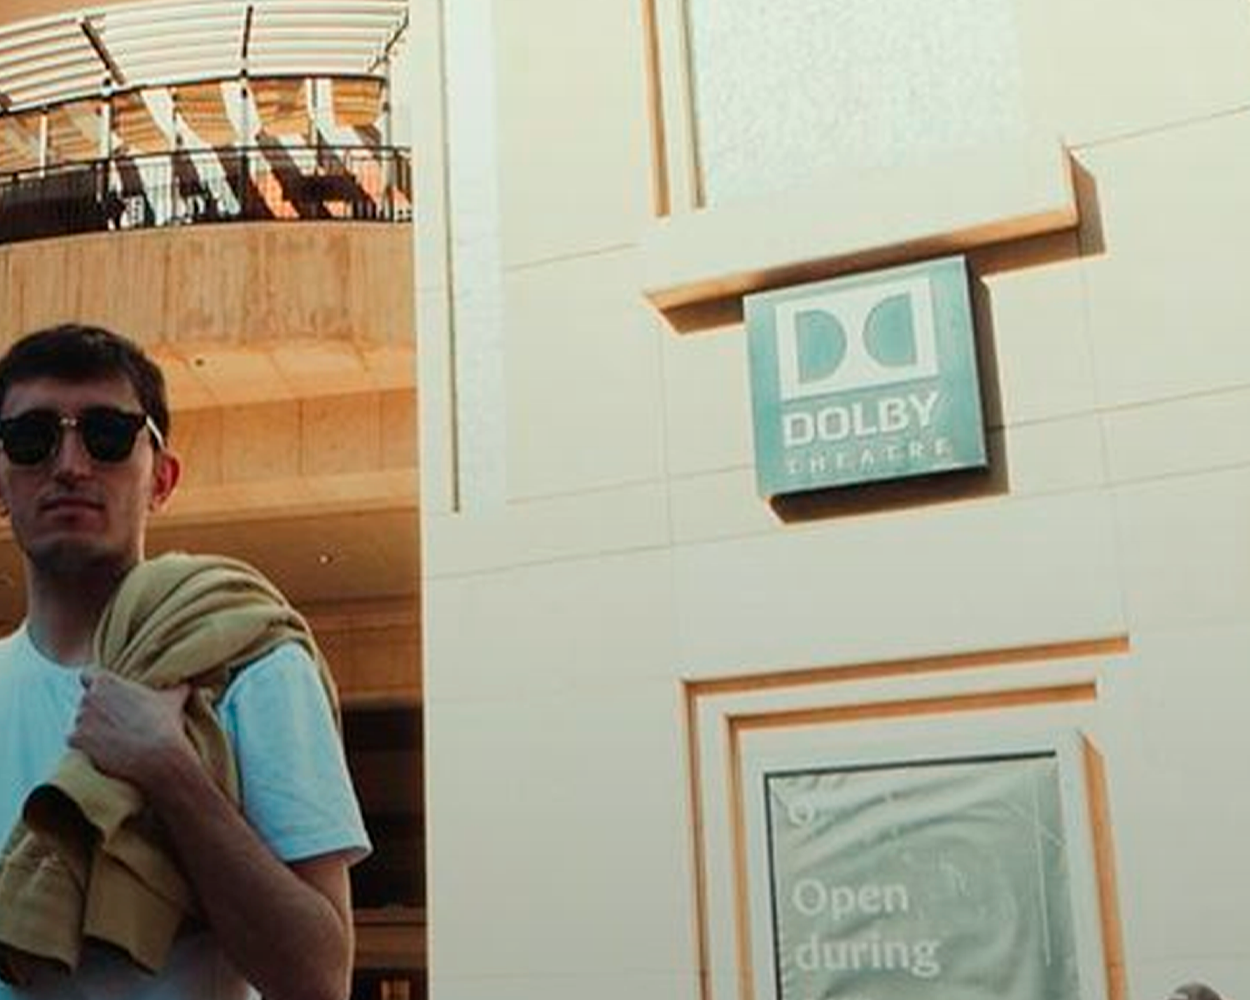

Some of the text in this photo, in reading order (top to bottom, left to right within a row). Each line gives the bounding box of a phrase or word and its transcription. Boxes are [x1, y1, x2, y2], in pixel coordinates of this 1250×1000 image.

[783, 391, 939, 448] DOLBY
[792, 878, 909, 921] Open
[796, 932, 941, 978] during
